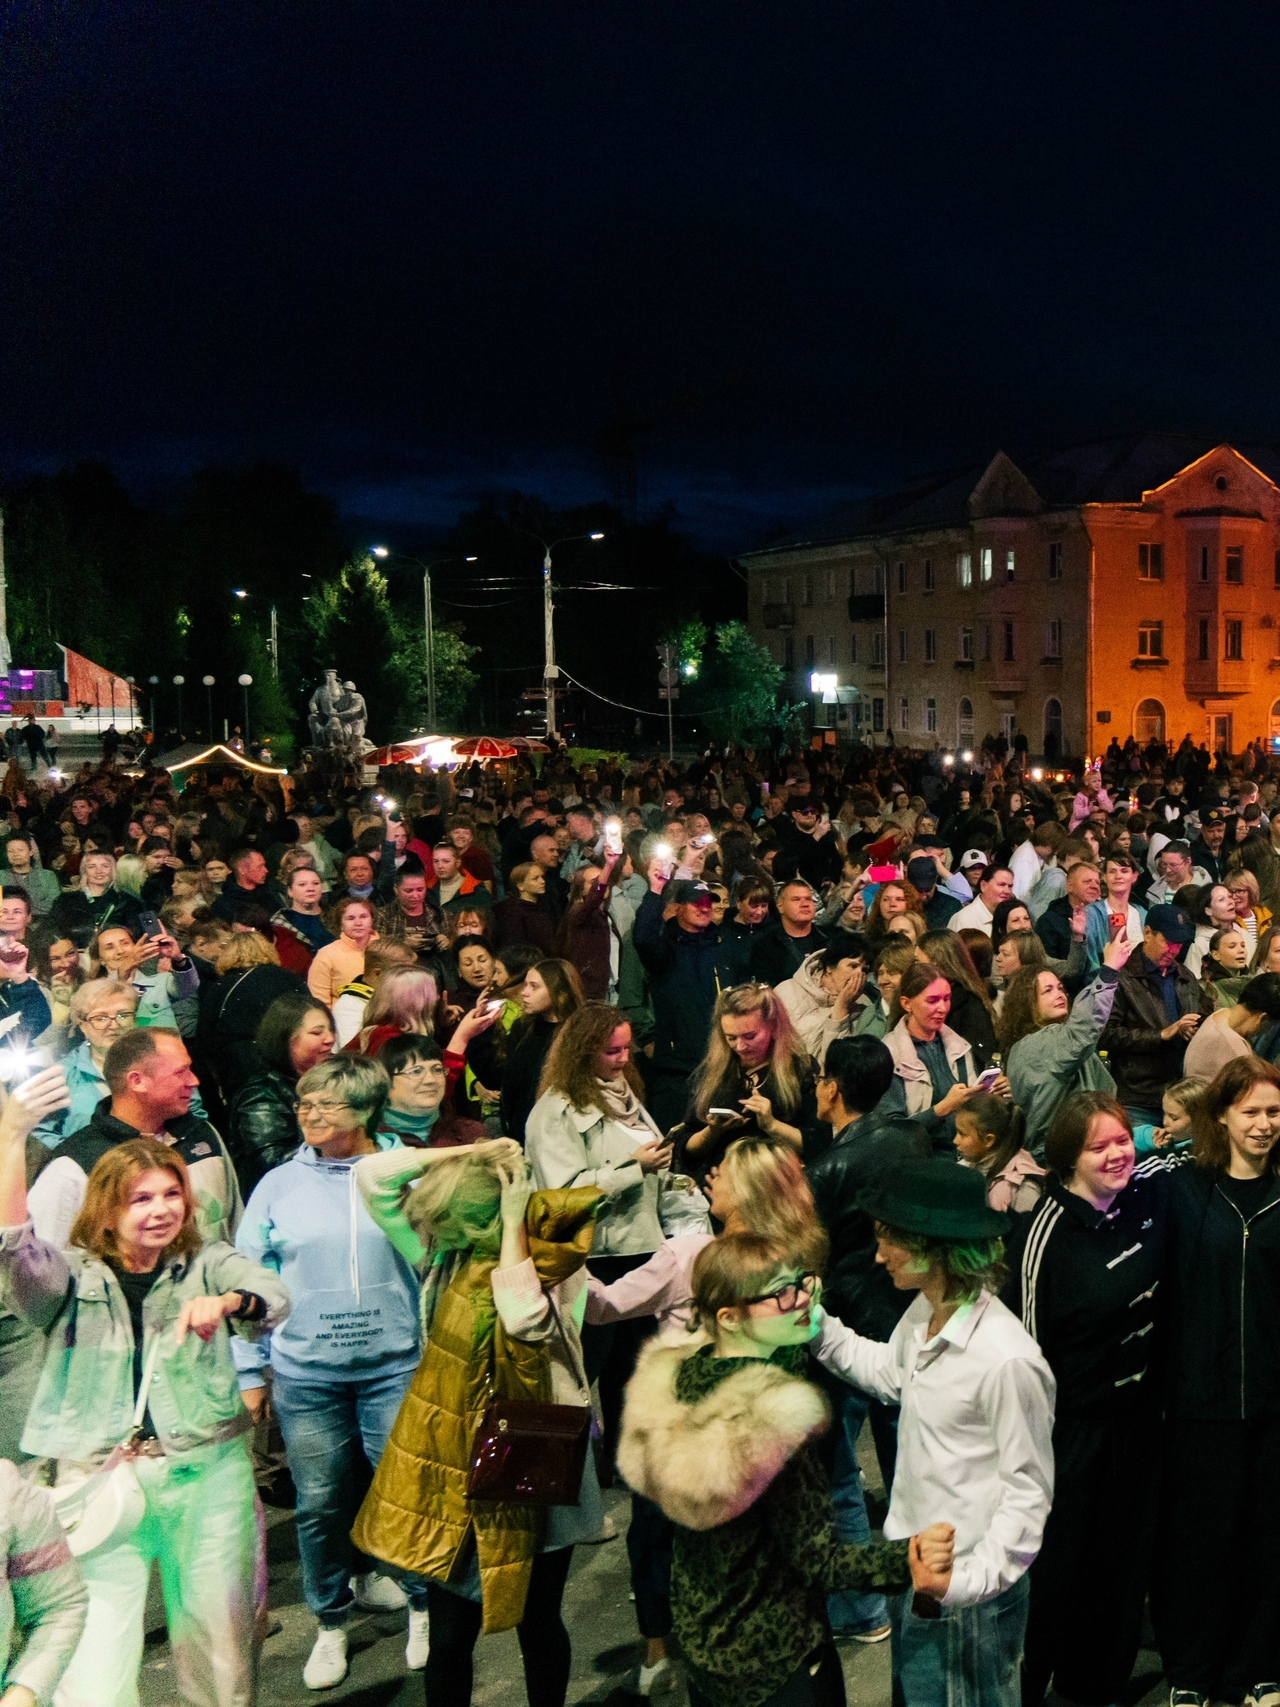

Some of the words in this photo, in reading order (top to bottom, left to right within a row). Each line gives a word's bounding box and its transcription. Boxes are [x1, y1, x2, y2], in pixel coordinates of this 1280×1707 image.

[319, 1310, 372, 1320] EVERYTHING
[373, 1308, 381, 1316] IS
[331, 1320, 370, 1330] AMAZING
[334, 1327, 384, 1339] EVERYBODY
